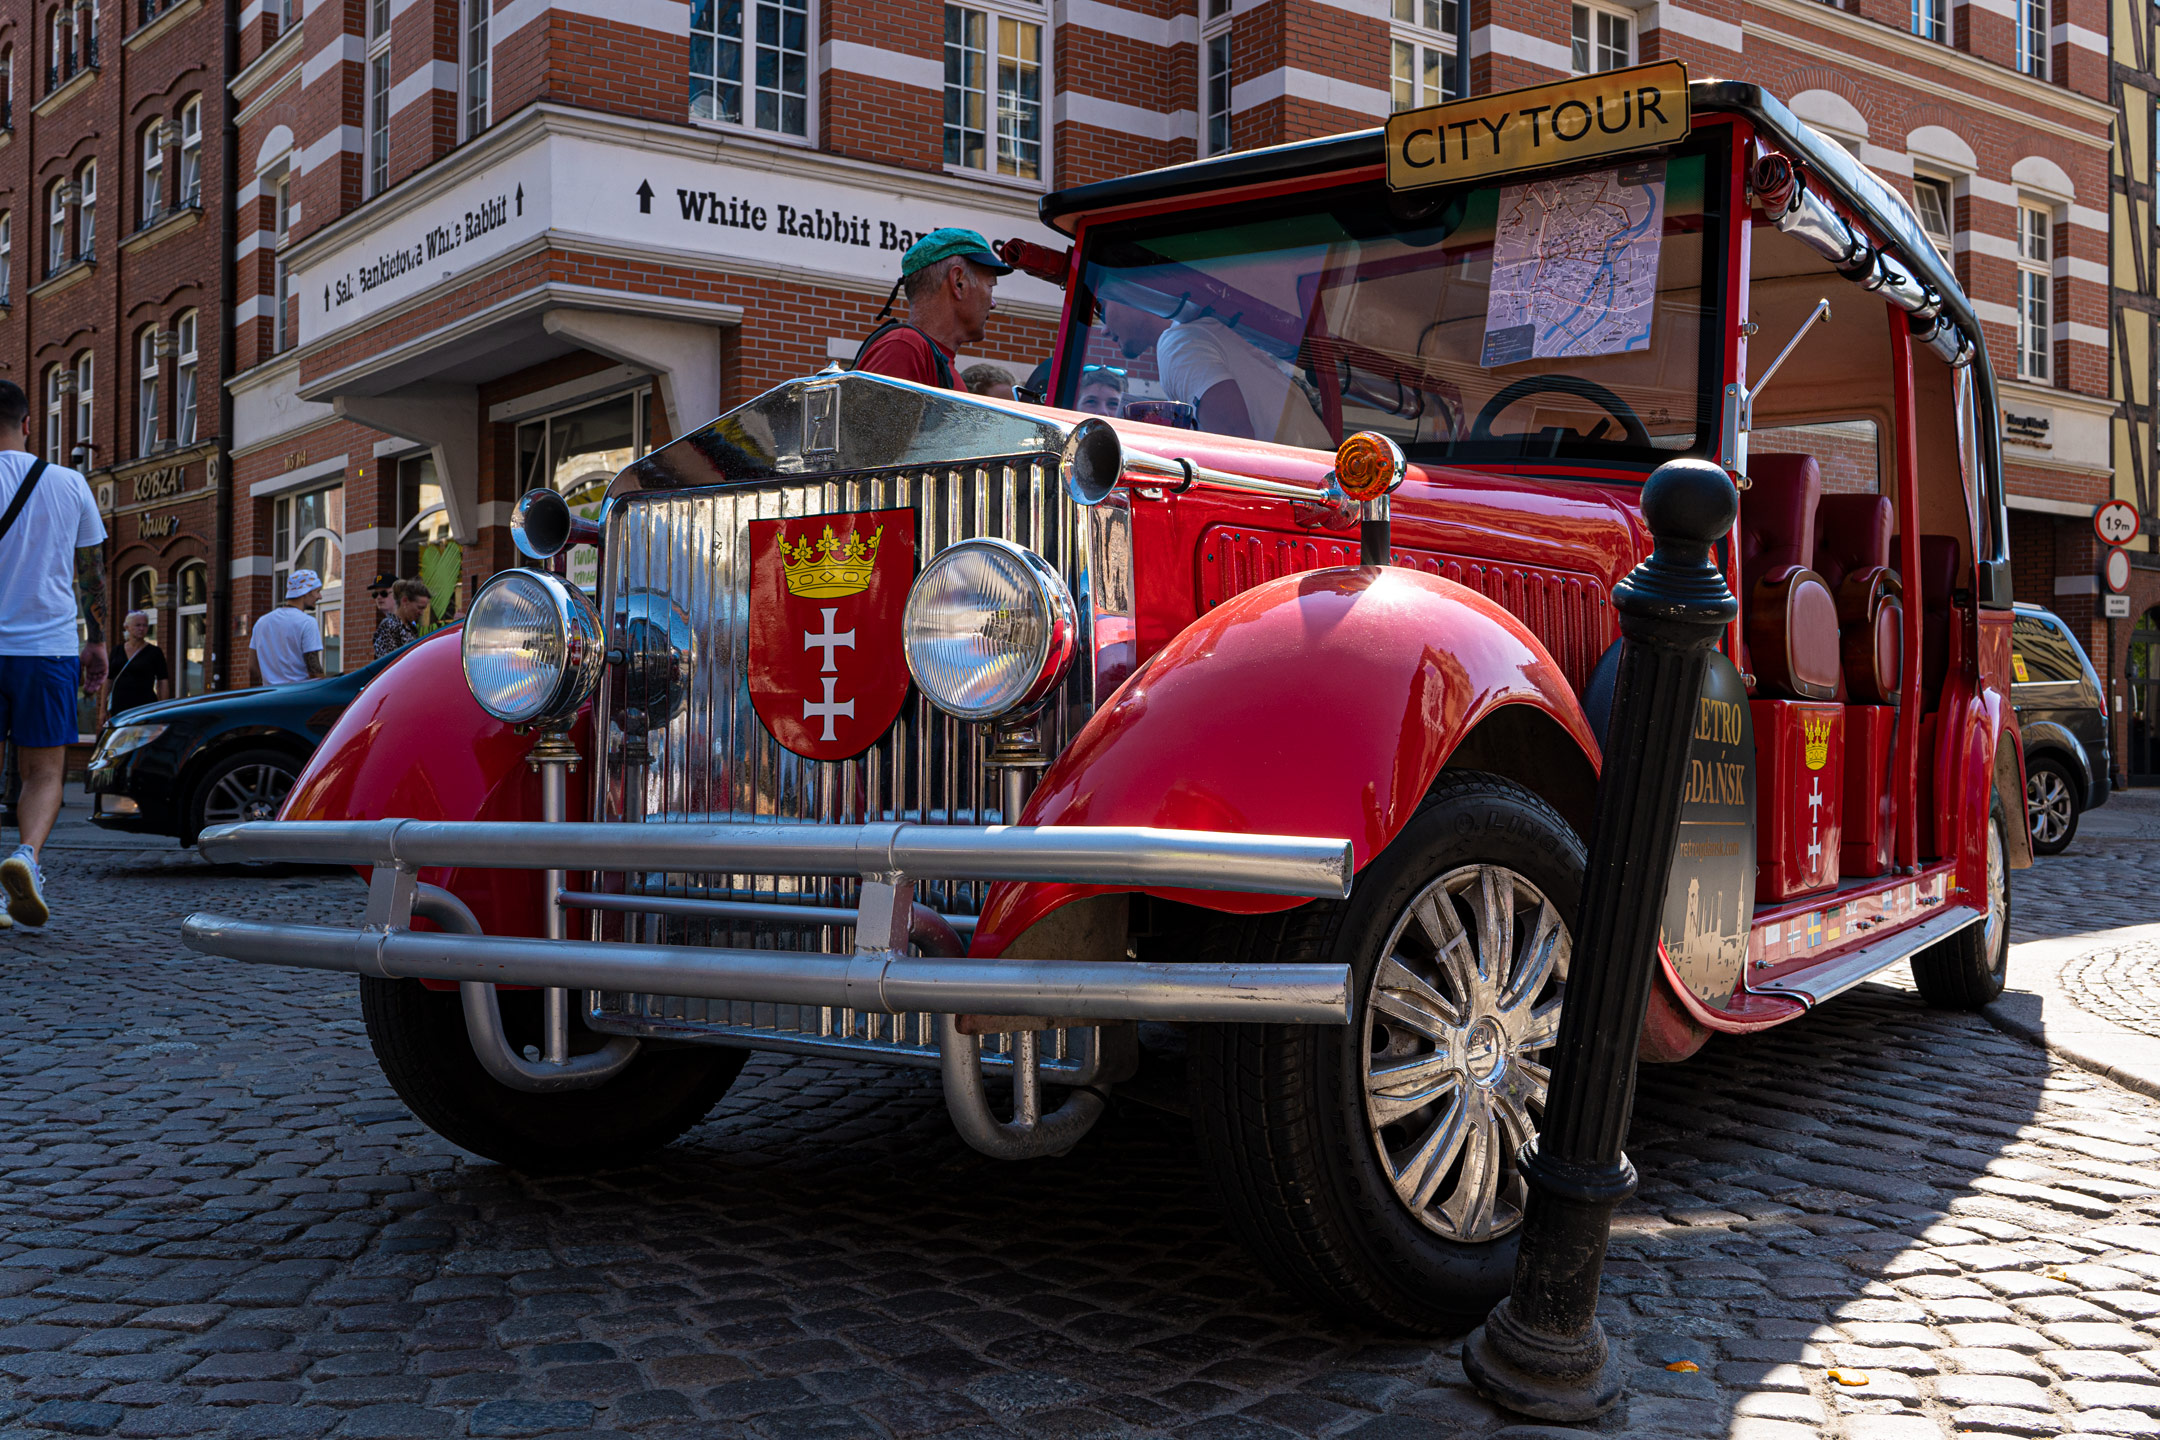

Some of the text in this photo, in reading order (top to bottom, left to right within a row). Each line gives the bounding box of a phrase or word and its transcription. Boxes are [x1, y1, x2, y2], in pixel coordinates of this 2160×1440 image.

[1402, 86, 1669, 169] CITY TOUR
[464, 194, 507, 243] Rabbit
[677, 188, 767, 231] White
[777, 204, 871, 248] Rabbit
[1694, 697, 1742, 746] ETRO
[1684, 750, 1745, 806] DAŃSK
